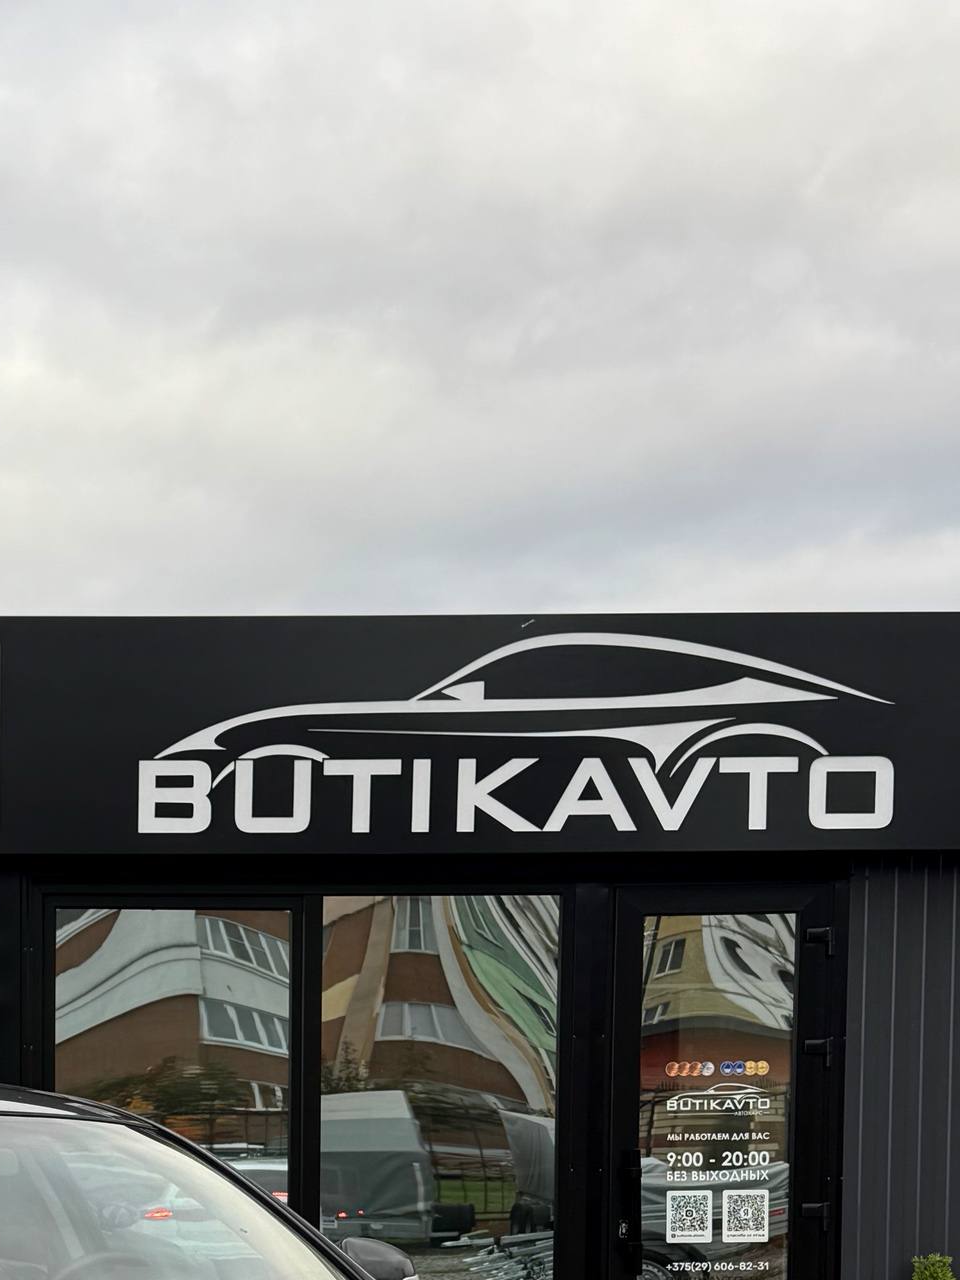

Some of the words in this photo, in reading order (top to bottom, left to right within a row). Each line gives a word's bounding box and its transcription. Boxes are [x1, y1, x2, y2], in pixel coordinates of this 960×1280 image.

[137, 754, 896, 834] BUTIKAVTO
[666, 1098, 770, 1112] BUTIKAVTO
[667, 1133, 682, 1141] МЫ
[684, 1133, 730, 1141] РАБОТАЕМ
[731, 1132, 750, 1141] ДЛЯ
[751, 1132, 770, 1140] ВАС
[666, 1152, 704, 1167] 9:00
[721, 1151, 770, 1167] 20:00
[666, 1171, 687, 1182] БЕЗ
[691, 1170, 769, 1182] ВЫХОДНЫХ
[665, 1262, 712, 1273] +375(29)
[714, 1262, 769, 1272] 606-82-31
